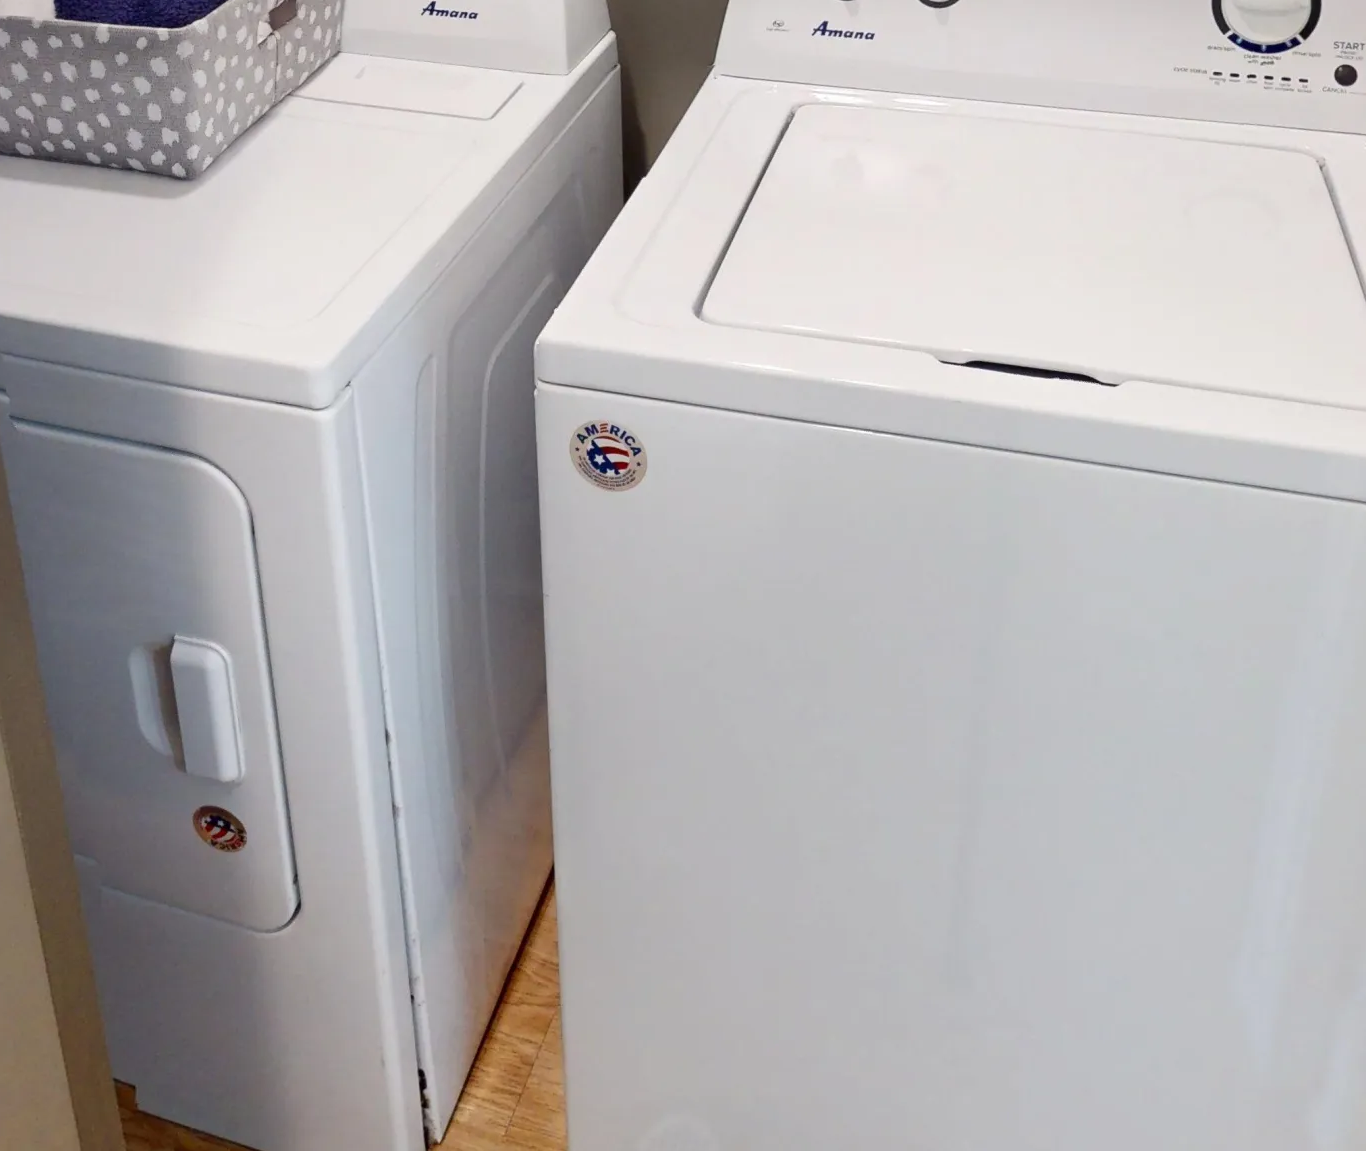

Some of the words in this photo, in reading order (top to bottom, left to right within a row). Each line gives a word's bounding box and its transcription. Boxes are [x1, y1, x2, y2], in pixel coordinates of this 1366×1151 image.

[421, 0, 479, 20] Amana
[811, 20, 876, 41] Amana
[1333, 40, 1366, 51] START
[576, 422, 642, 457] AMERICA
